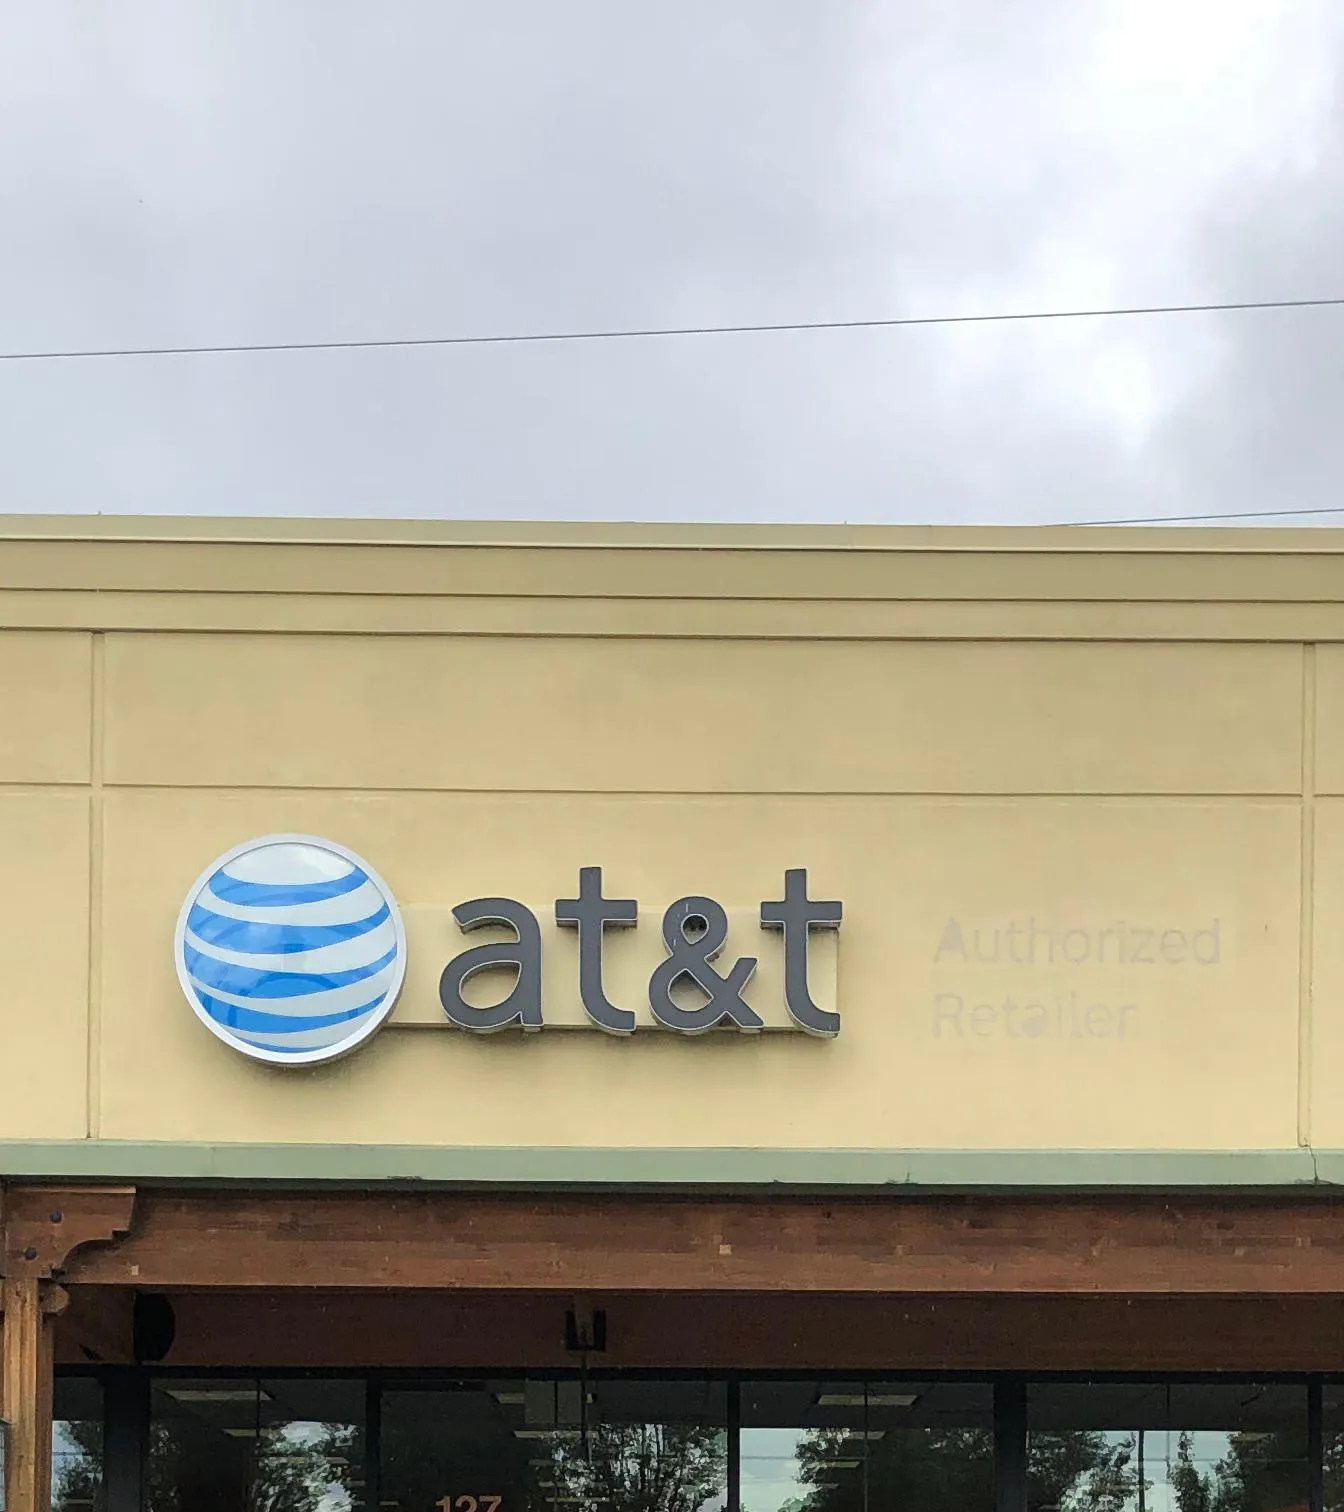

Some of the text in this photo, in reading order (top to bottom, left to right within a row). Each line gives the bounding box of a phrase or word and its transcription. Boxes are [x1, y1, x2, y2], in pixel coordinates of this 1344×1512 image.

[439, 866, 843, 1036] at&t
[932, 915, 1222, 965] Authorized
[931, 990, 1136, 1040] Retailer
